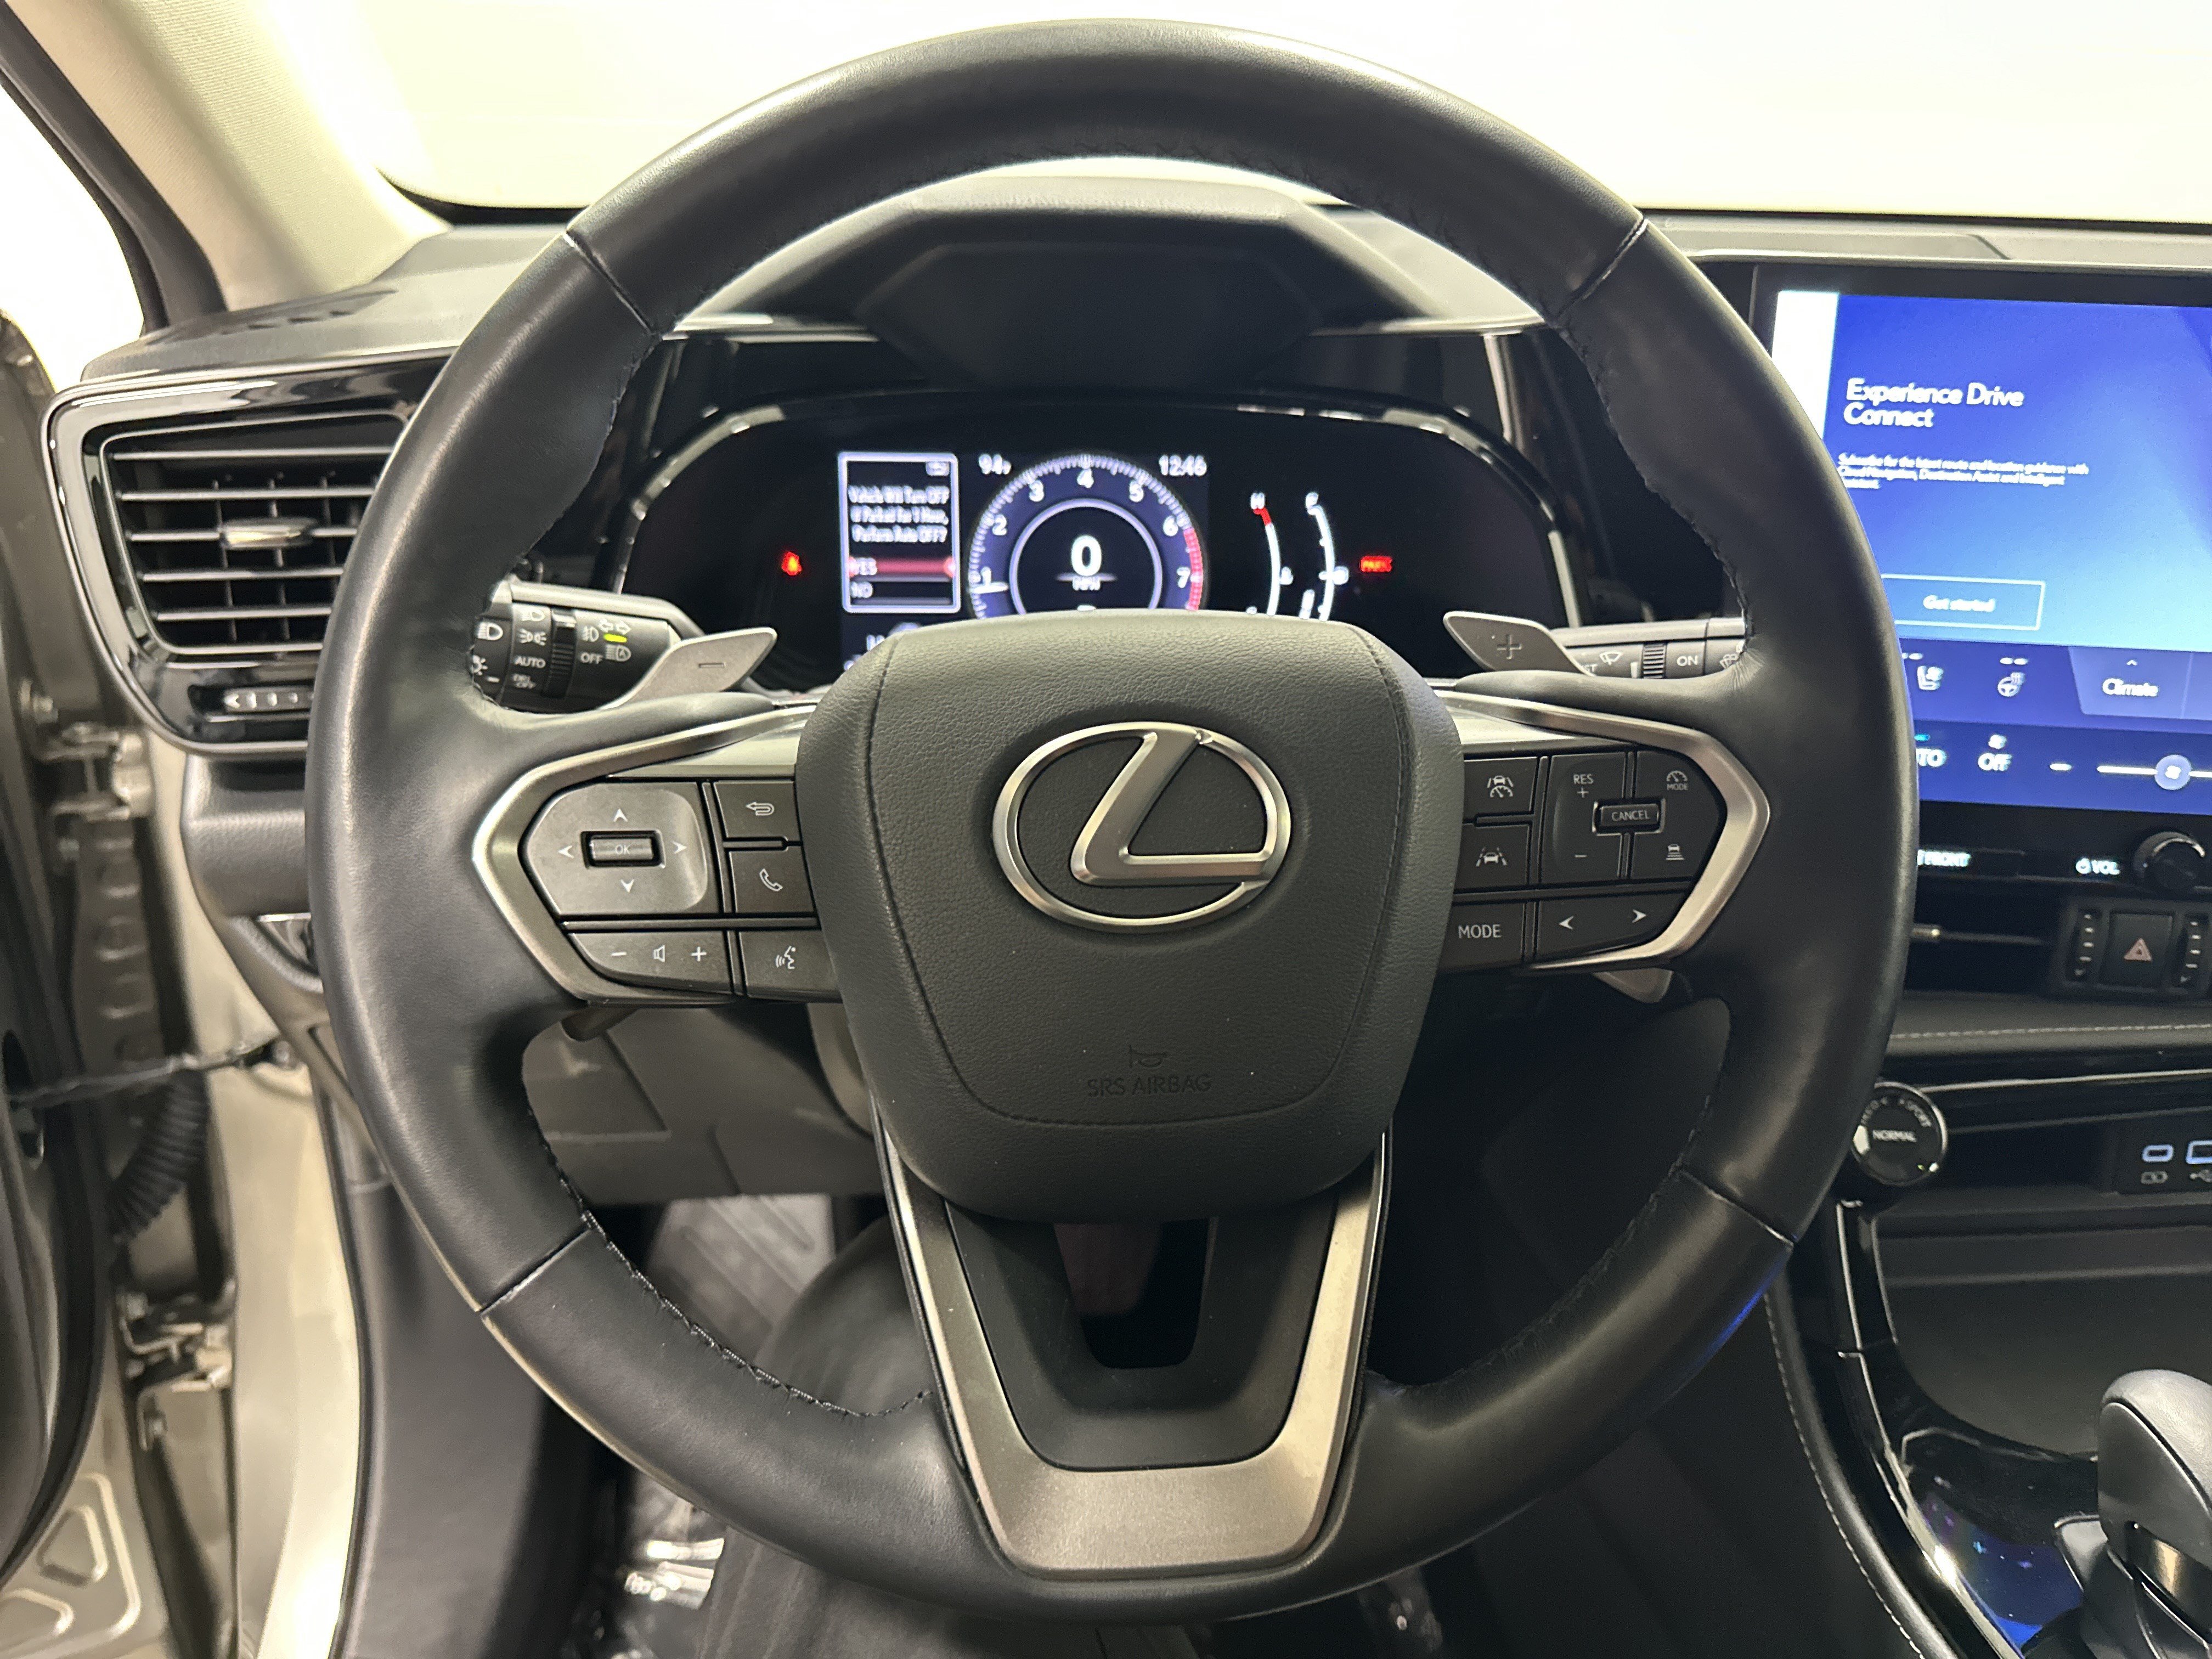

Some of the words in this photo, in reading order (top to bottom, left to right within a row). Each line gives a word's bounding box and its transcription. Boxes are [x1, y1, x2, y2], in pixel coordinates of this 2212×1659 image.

[1846, 377, 1963, 406] Experience
[1966, 382, 2025, 407] Drive
[1843, 403, 1934, 427] Connect
[1077, 468, 1094, 488] 4
[1029, 480, 1044, 502] 3
[1129, 480, 1144, 503] 5
[992, 515, 1007, 535] 2
[1163, 518, 1178, 537] 6
[1071, 535, 1102, 576] 0
[1177, 567, 1191, 588] 7
[515, 656, 546, 669] AUTO
[580, 652, 603, 664] OFF
[1677, 656, 1699, 667] ON
[2102, 679, 2159, 697] Climate
[1573, 774, 1594, 785] RES
[1611, 810, 1650, 821] CANCEL
[615, 844, 631, 855] OK
[1925, 851, 1971, 867] FRONT
[2092, 859, 2120, 876] VOL
[1458, 924, 1502, 939] MODE
[1087, 1077, 1125, 1097] SRS
[1132, 1074, 1212, 1096] AIRBAG
[1872, 1130, 1918, 1143] NORMAL
